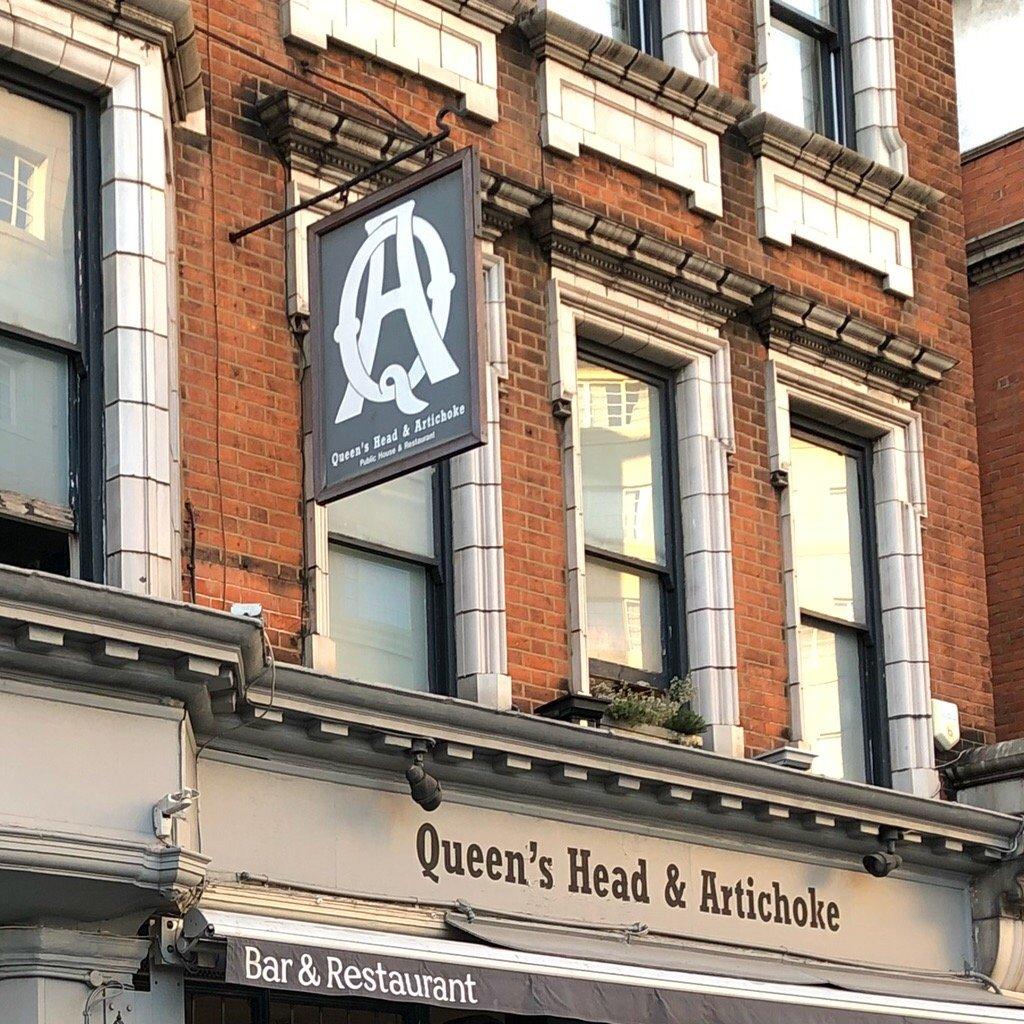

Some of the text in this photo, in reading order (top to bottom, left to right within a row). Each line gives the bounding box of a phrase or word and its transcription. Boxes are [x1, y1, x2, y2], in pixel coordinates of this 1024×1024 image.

[331, 404, 466, 467] Queen's Head & Artichoke
[359, 431, 436, 467] Public House & Restaurant
[416, 822, 841, 932] Queen's Head & Artichoke
[244, 946, 478, 1004] Bar & Restaurant
